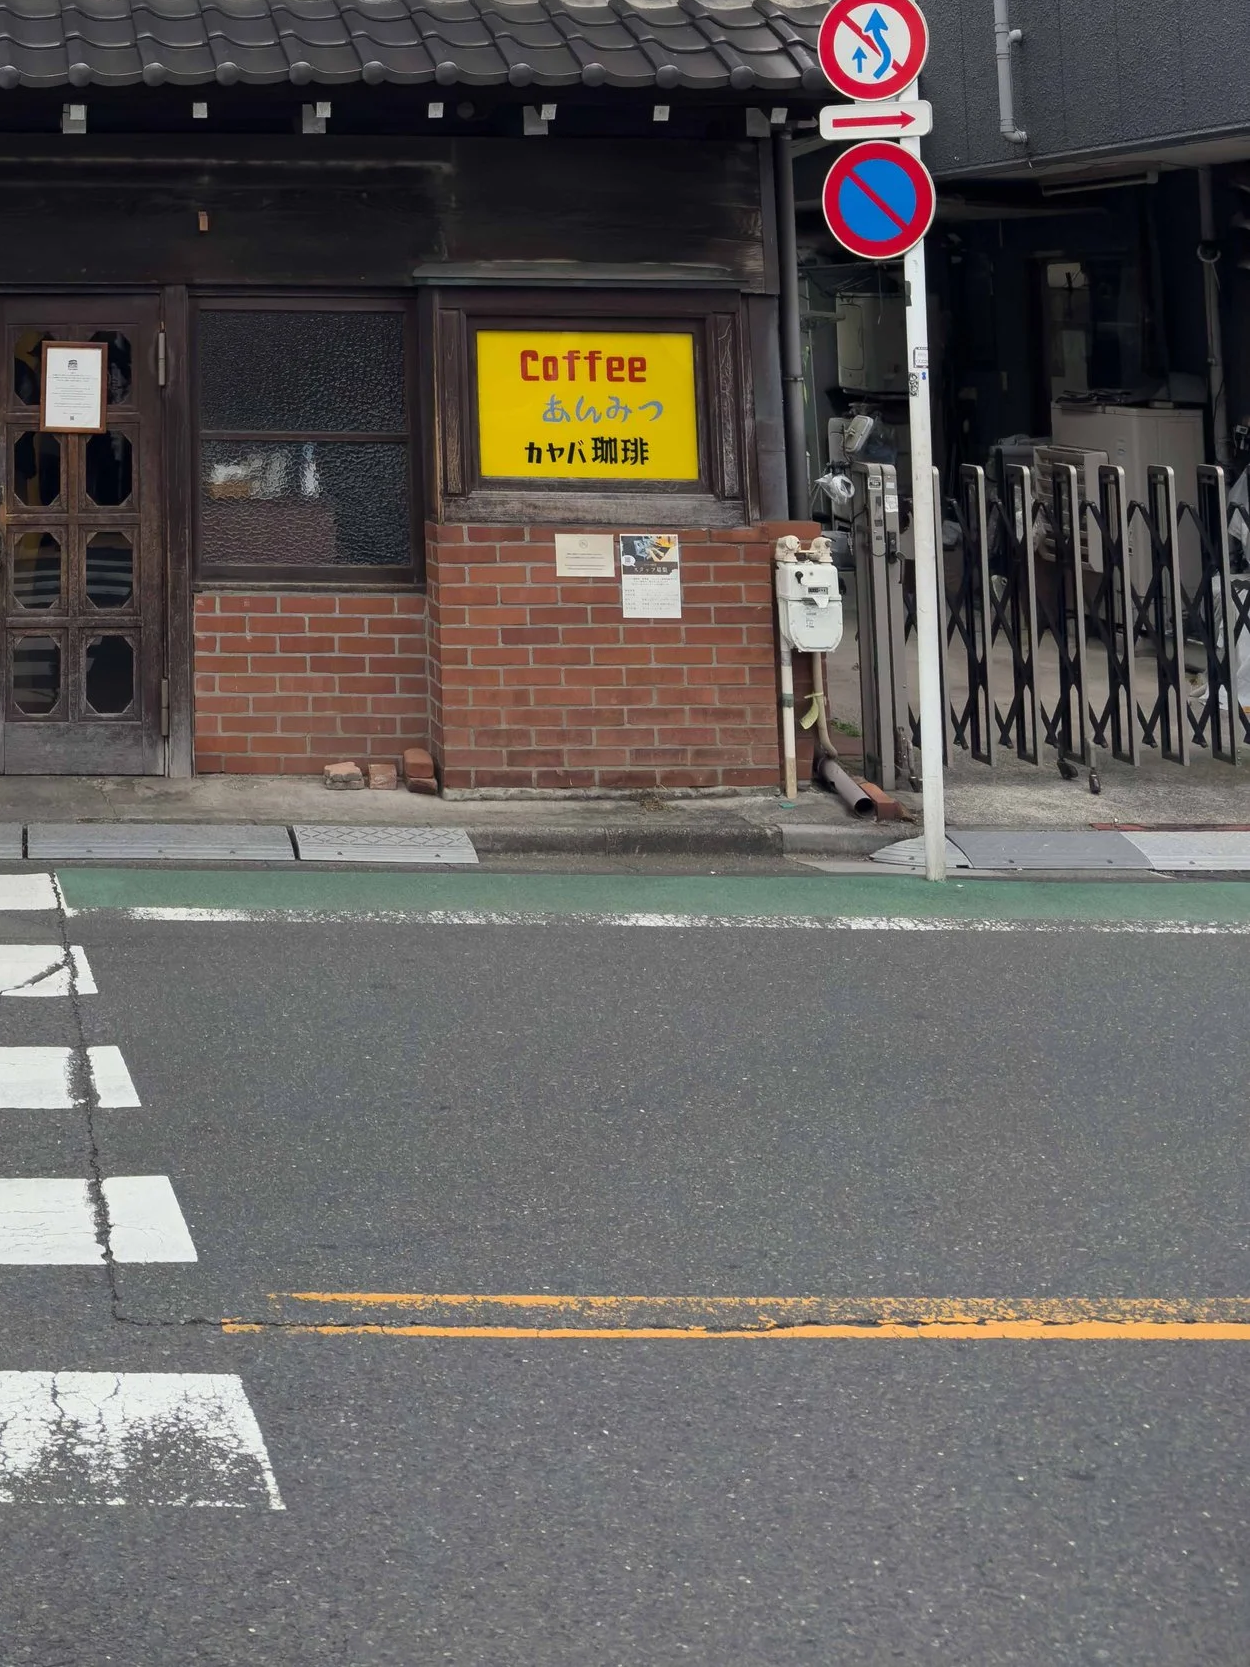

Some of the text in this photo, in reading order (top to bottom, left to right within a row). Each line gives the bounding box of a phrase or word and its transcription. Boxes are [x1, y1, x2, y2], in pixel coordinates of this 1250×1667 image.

[519, 349, 648, 383] Coffee
[541, 393, 664, 424] あんみつ
[524, 436, 650, 466] カヤバ珈琲
